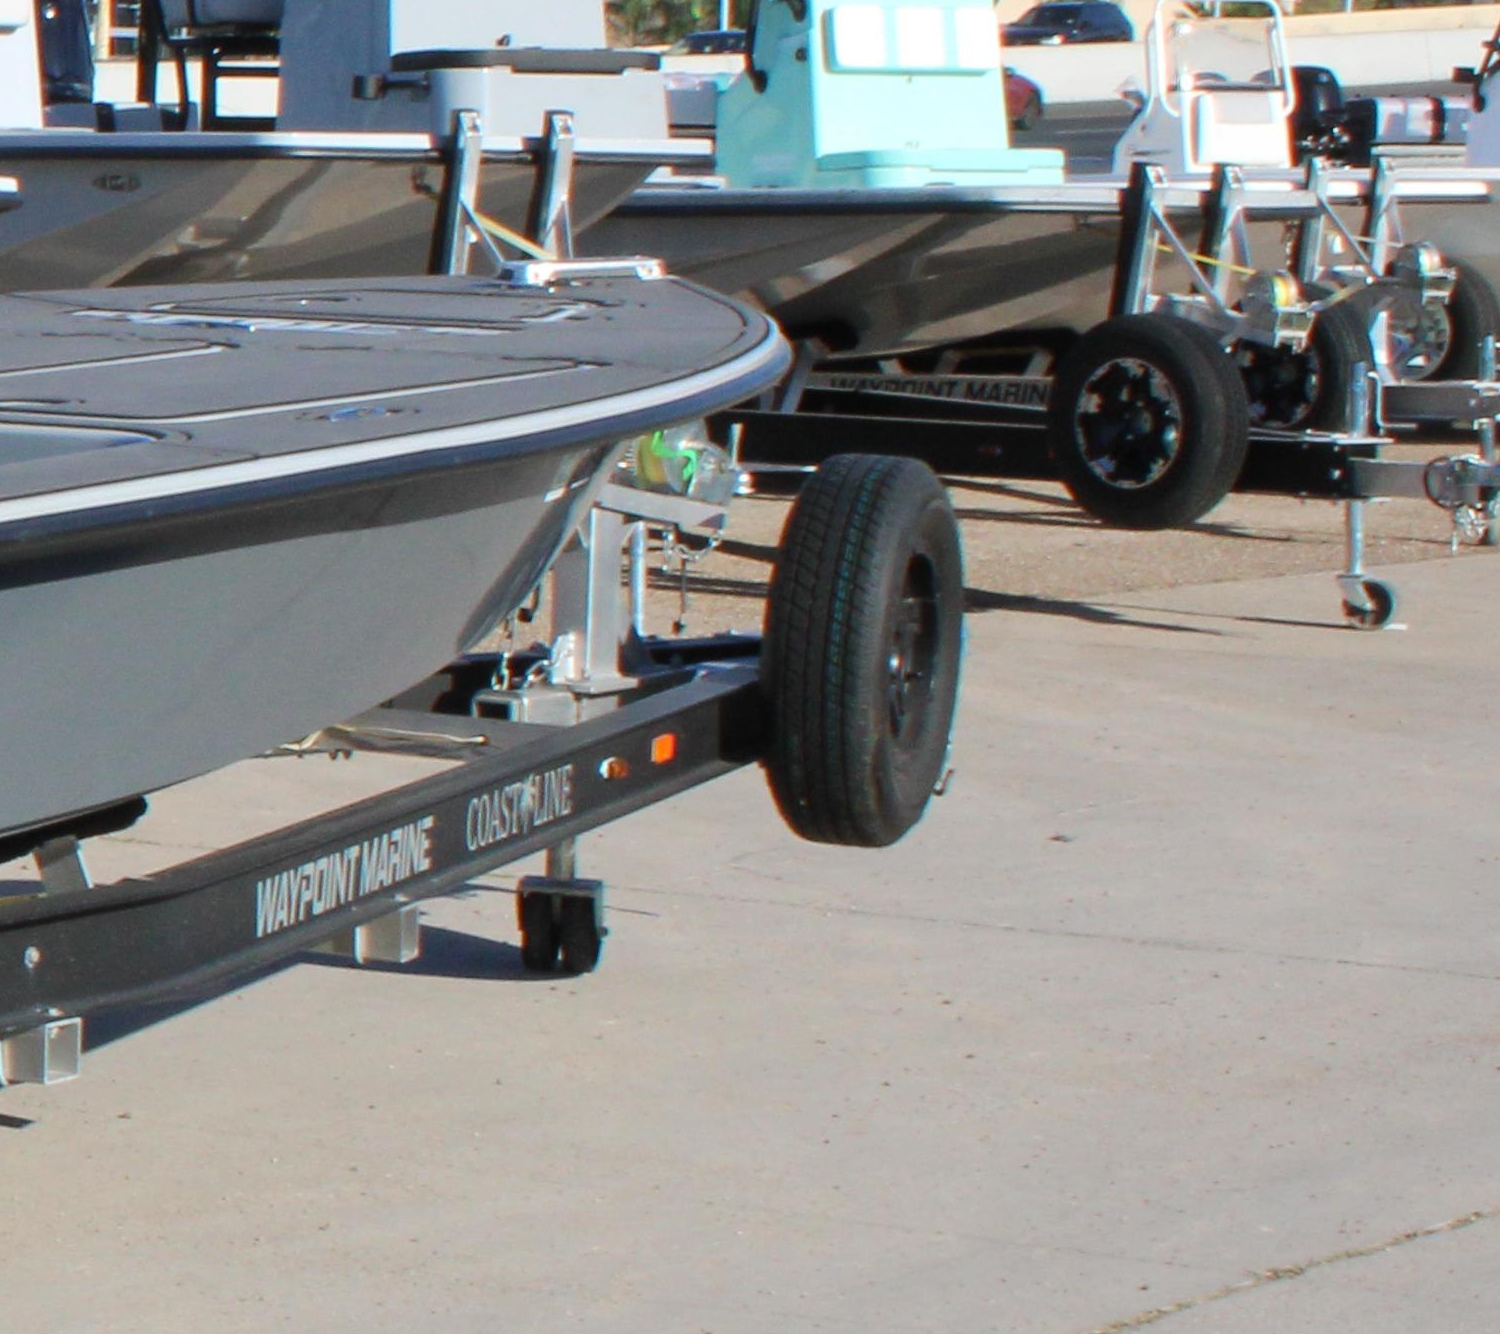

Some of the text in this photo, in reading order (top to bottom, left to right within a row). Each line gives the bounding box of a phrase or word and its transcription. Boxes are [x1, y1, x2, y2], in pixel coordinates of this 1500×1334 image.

[465, 763, 574, 852] COAST LINE
[256, 814, 434, 938] WAYPOINT MARINE
